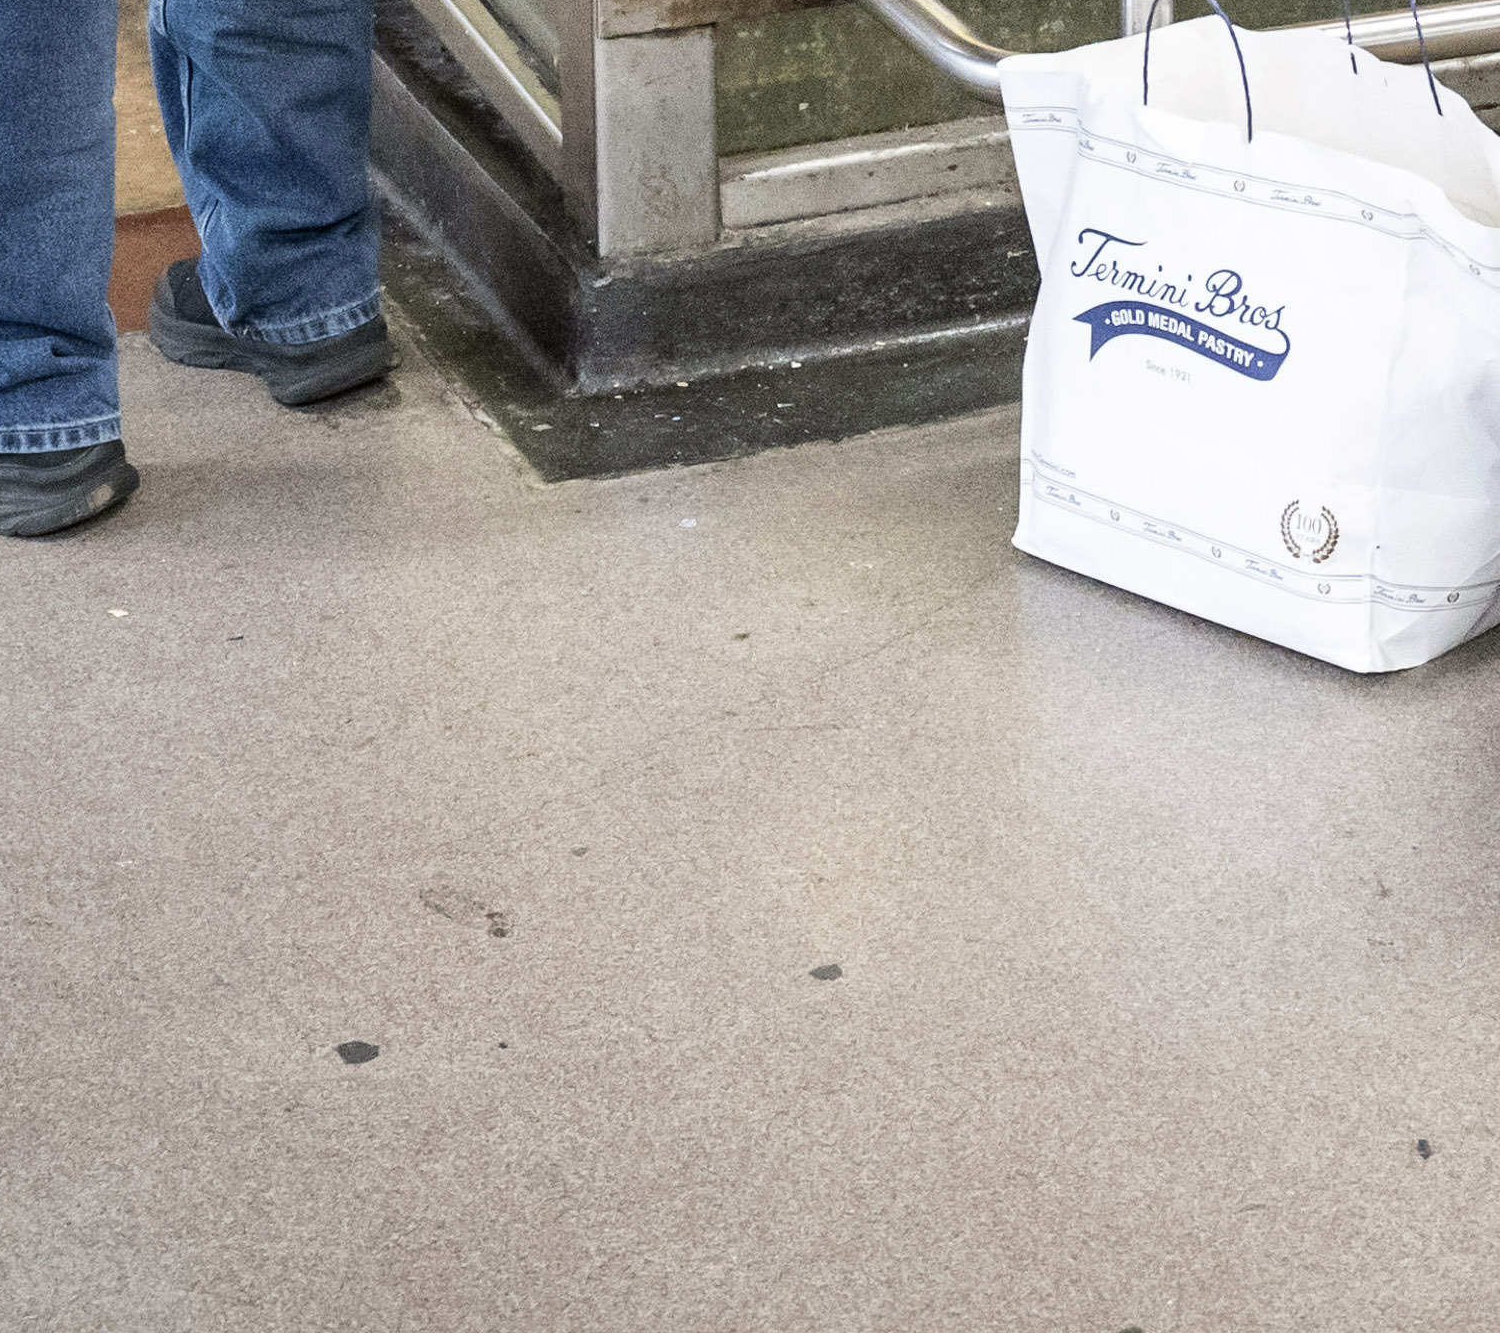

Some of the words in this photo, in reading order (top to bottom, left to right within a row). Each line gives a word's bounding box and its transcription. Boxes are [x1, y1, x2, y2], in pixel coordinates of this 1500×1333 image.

[1070, 228, 1191, 308] Termini
[1194, 269, 1287, 331] Bros
[1110, 309, 1145, 327] GOLD
[1147, 312, 1196, 343] MEDAL
[1197, 331, 1255, 369] PASTRY
[1169, 368, 1193, 384] 1921
[1296, 513, 1323, 535] 100
